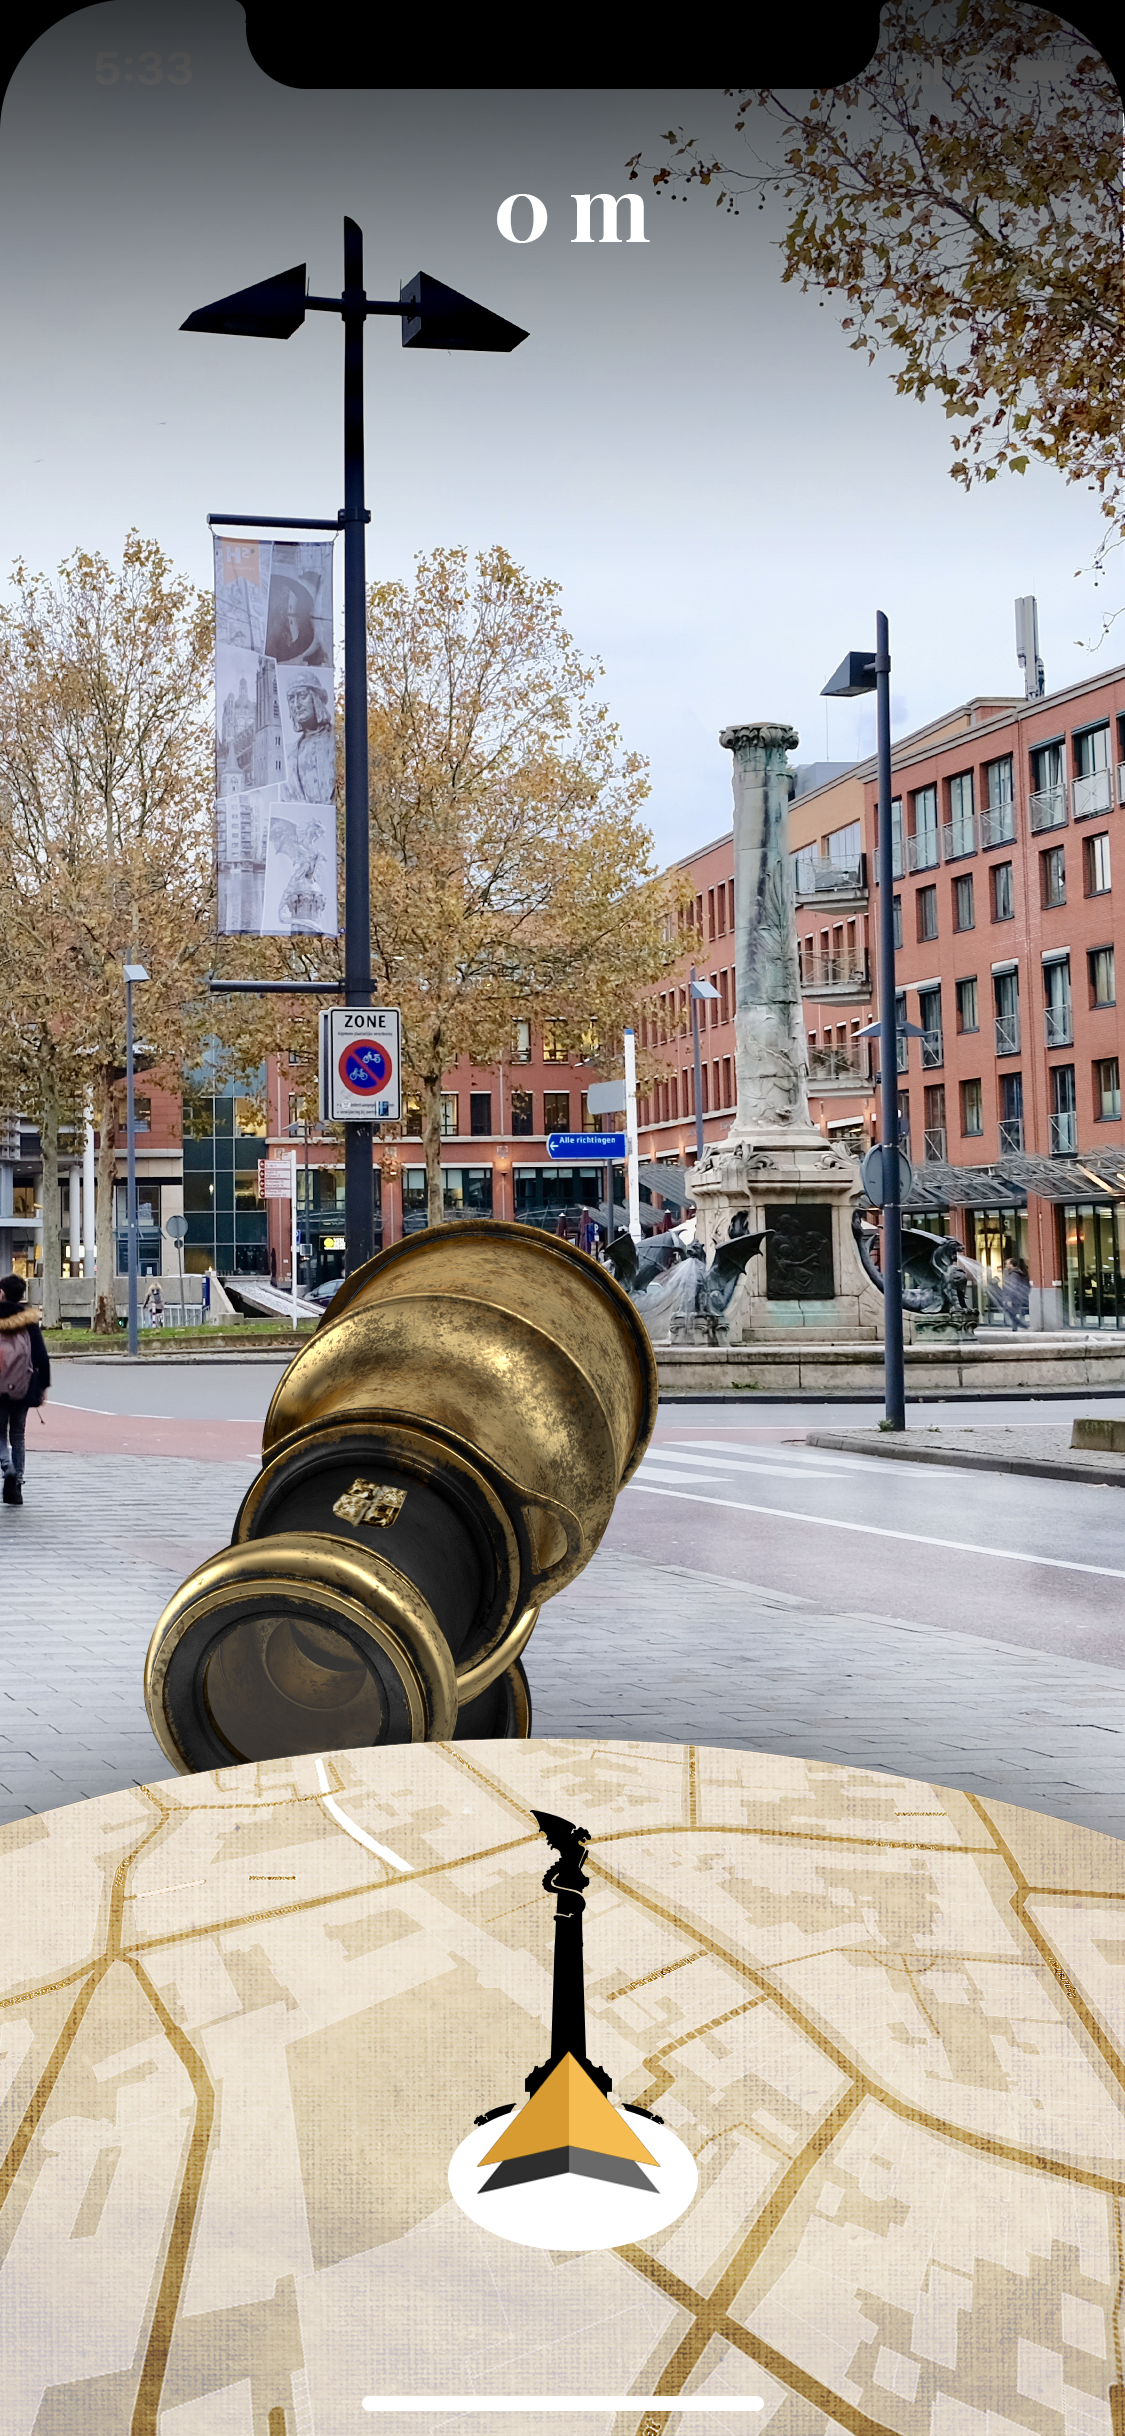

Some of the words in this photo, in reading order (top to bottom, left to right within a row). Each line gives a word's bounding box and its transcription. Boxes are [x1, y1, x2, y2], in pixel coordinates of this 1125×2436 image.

[344, 1014, 387, 1028] ZONE
[559, 1136, 575, 1144] Alle
[576, 1136, 616, 1145] richtingen
